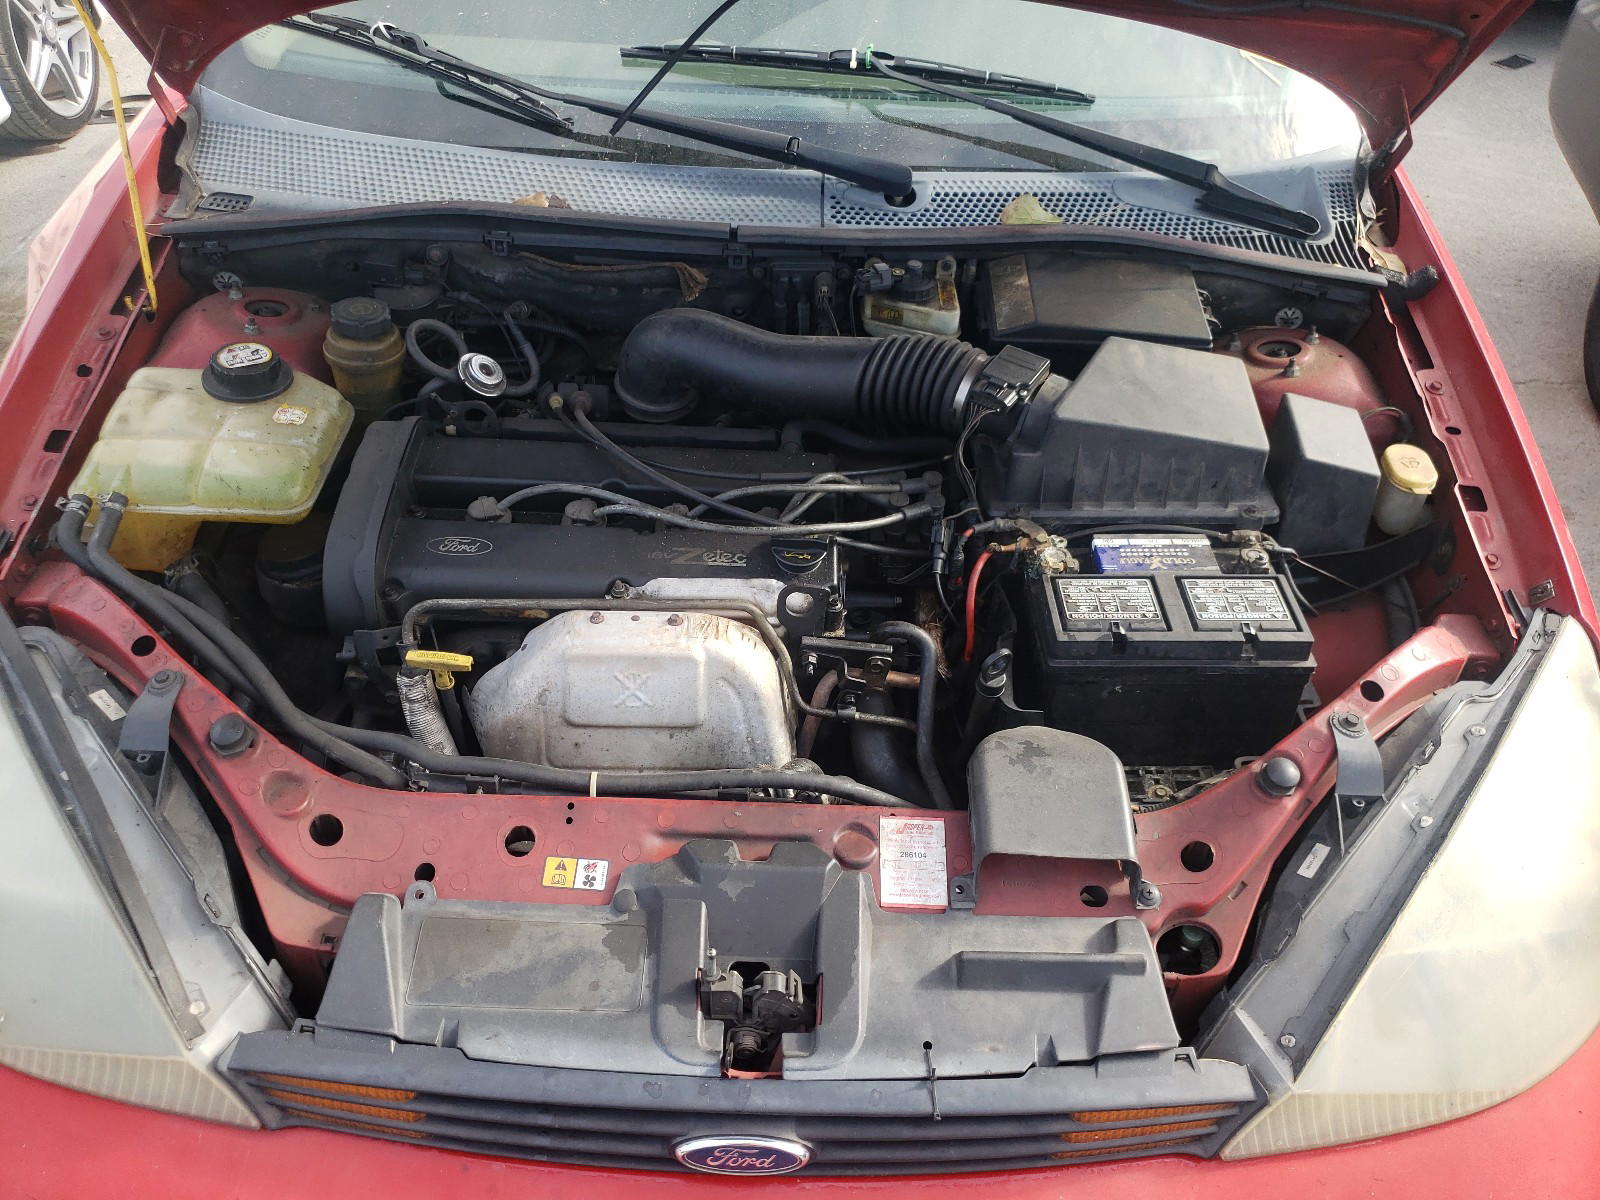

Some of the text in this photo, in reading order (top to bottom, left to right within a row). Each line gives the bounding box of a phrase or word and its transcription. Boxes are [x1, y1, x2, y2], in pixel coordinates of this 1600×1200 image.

[439, 538, 481, 552] Ford
[671, 547, 747, 566] Zetec
[1162, 557, 1196, 565] GOLD
[899, 851, 927, 859] 286104
[706, 1147, 777, 1168] Ford
